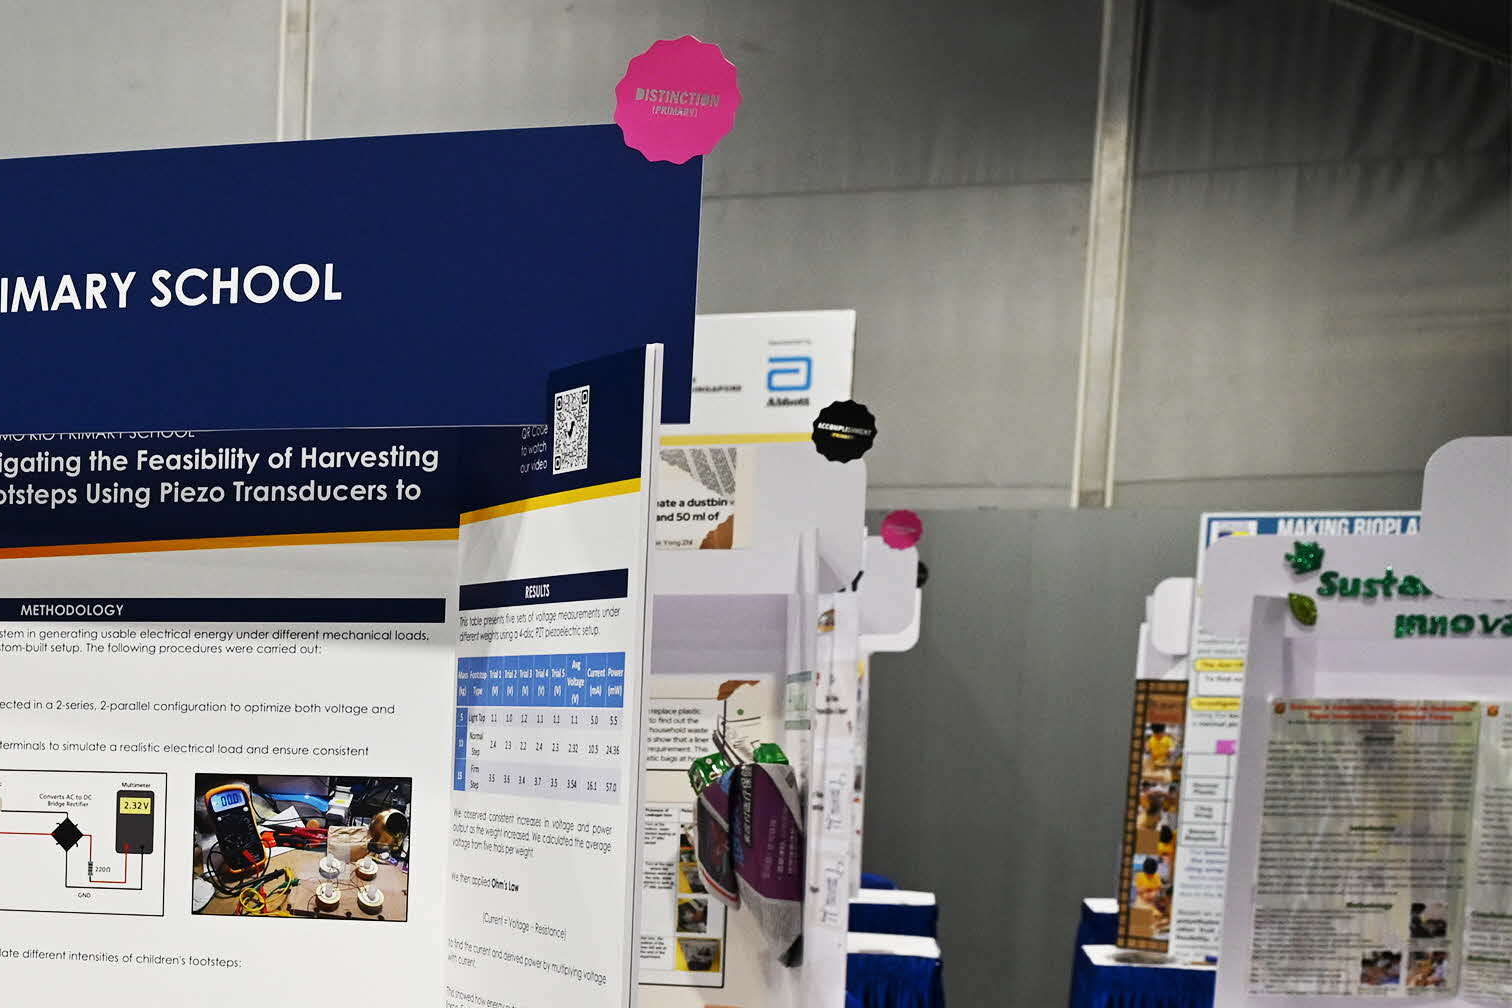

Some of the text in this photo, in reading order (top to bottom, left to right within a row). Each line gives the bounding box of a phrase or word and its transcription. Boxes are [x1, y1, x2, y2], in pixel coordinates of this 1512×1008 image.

[634, 86, 720, 108] DISTINCTION
[651, 105, 698, 117] (PRIMARY)
[149, 262, 342, 308] SCHOOL
[521, 442, 547, 456] to watch
[88, 449, 128, 472] the
[136, 446, 260, 475] Feasibility
[267, 446, 294, 469] of
[300, 444, 439, 473] Harvesting
[520, 459, 548, 474] our video
[86, 481, 151, 509] Using
[159, 480, 225, 503] Piezo
[232, 478, 388, 502] Transducers
[395, 478, 422, 501] to
[657, 499, 676, 507] ate
[687, 498, 727, 507] dustbin
[676, 513, 690, 521] 50
[693, 512, 705, 521] ml
[708, 512, 719, 521] of
[1278, 519, 1349, 535] MAKING
[525, 584, 550, 598] RESULTS
[20, 604, 124, 616] METHODOLOGY
[491, 878, 519, 892] Ohm's Law
